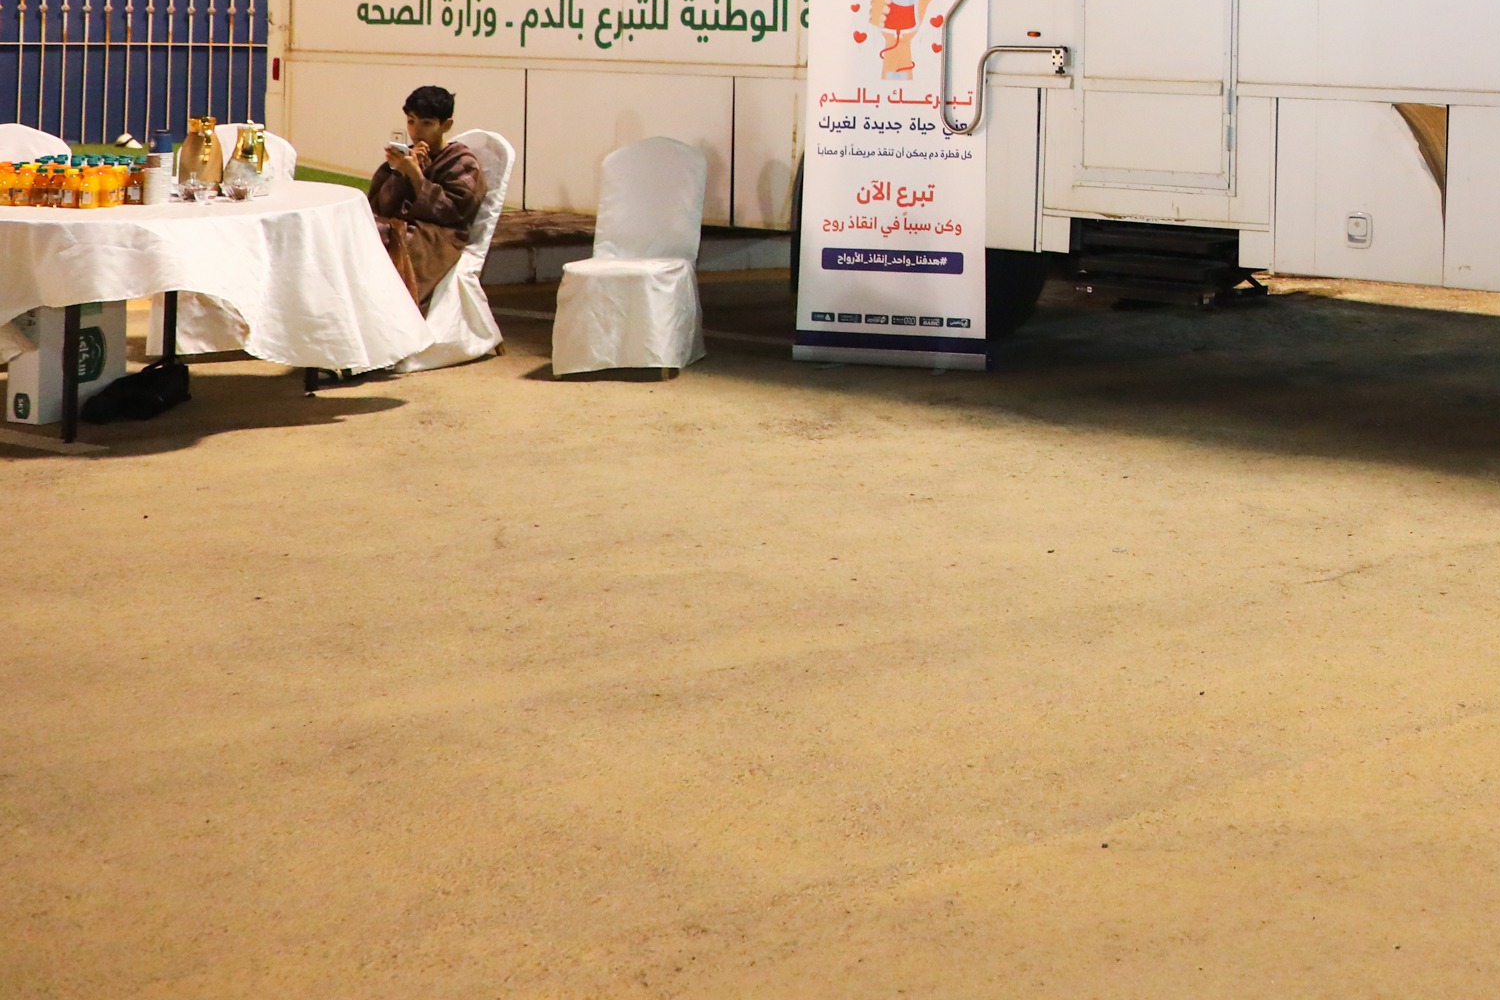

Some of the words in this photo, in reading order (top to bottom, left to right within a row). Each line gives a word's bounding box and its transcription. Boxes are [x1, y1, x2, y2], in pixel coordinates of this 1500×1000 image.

[818, 115, 856, 133] لغيرك
[863, 116, 903, 134] جديدة
[909, 116, 936, 135] حياة
[839, 145, 848, 158] أو
[877, 146, 894, 158] تنقذ
[895, 146, 905, 158] أن
[906, 147, 927, 160] يمكن
[928, 151, 939, 160] دم
[940, 148, 959, 160] قطرة
[961, 150, 973, 160] كل
[856, 179, 891, 204] الآن
[896, 184, 935, 207] تبرع
[822, 219, 845, 233] روح
[847, 215, 877, 230] انقاذ
[880, 216, 900, 238] في
[934, 219, 963, 236] وكن
